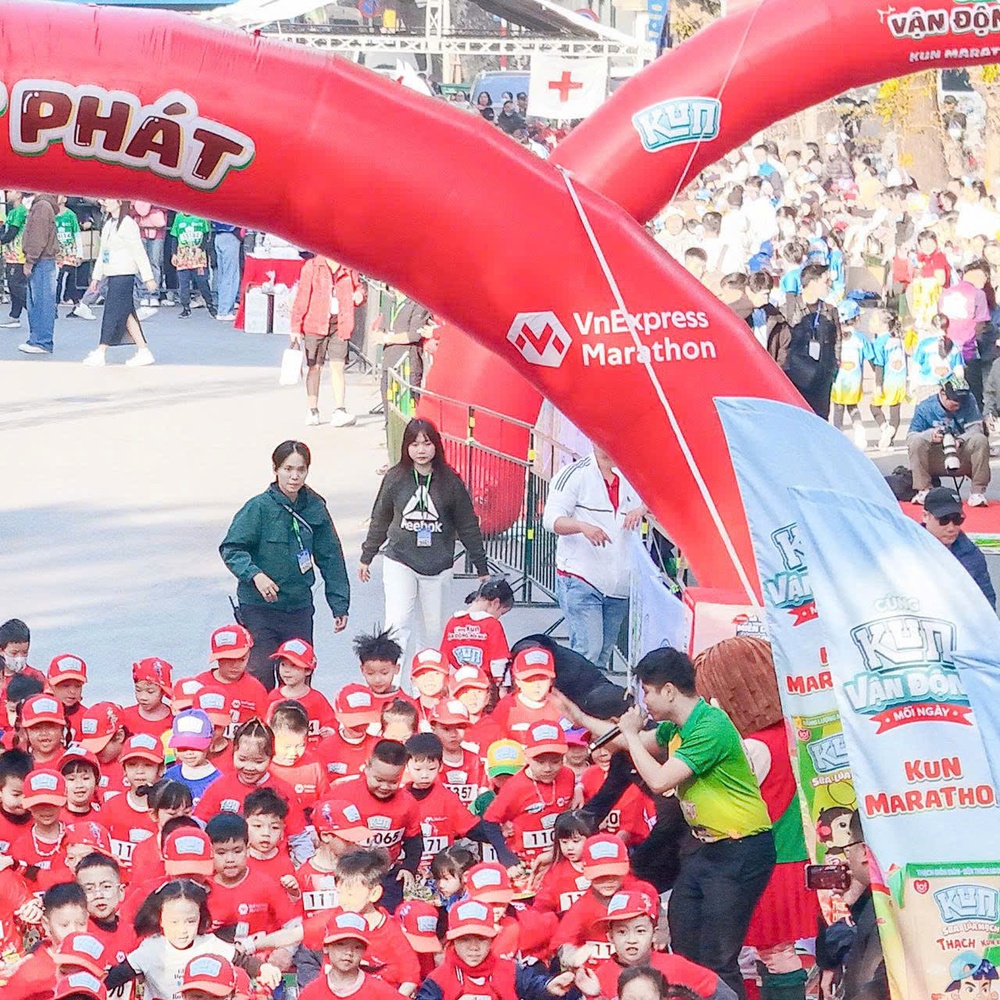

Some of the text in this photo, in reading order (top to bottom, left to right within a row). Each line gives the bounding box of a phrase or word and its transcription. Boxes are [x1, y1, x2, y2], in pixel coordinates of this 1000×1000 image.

[891, 10, 945, 37] VẬN
[909, 49, 941, 62] KUN
[19, 89, 243, 180] PHÁT
[572, 309, 709, 336] VnExpress
[581, 336, 717, 367] Marathon
[786, 671, 833, 694] MAR
[845, 664, 968, 710] VẬN ĐỘN
[893, 703, 951, 723] MỖI NGÀY
[904, 756, 962, 783] KUN
[864, 784, 995, 817] MARATHO
[936, 937, 976, 952] THẠCH
